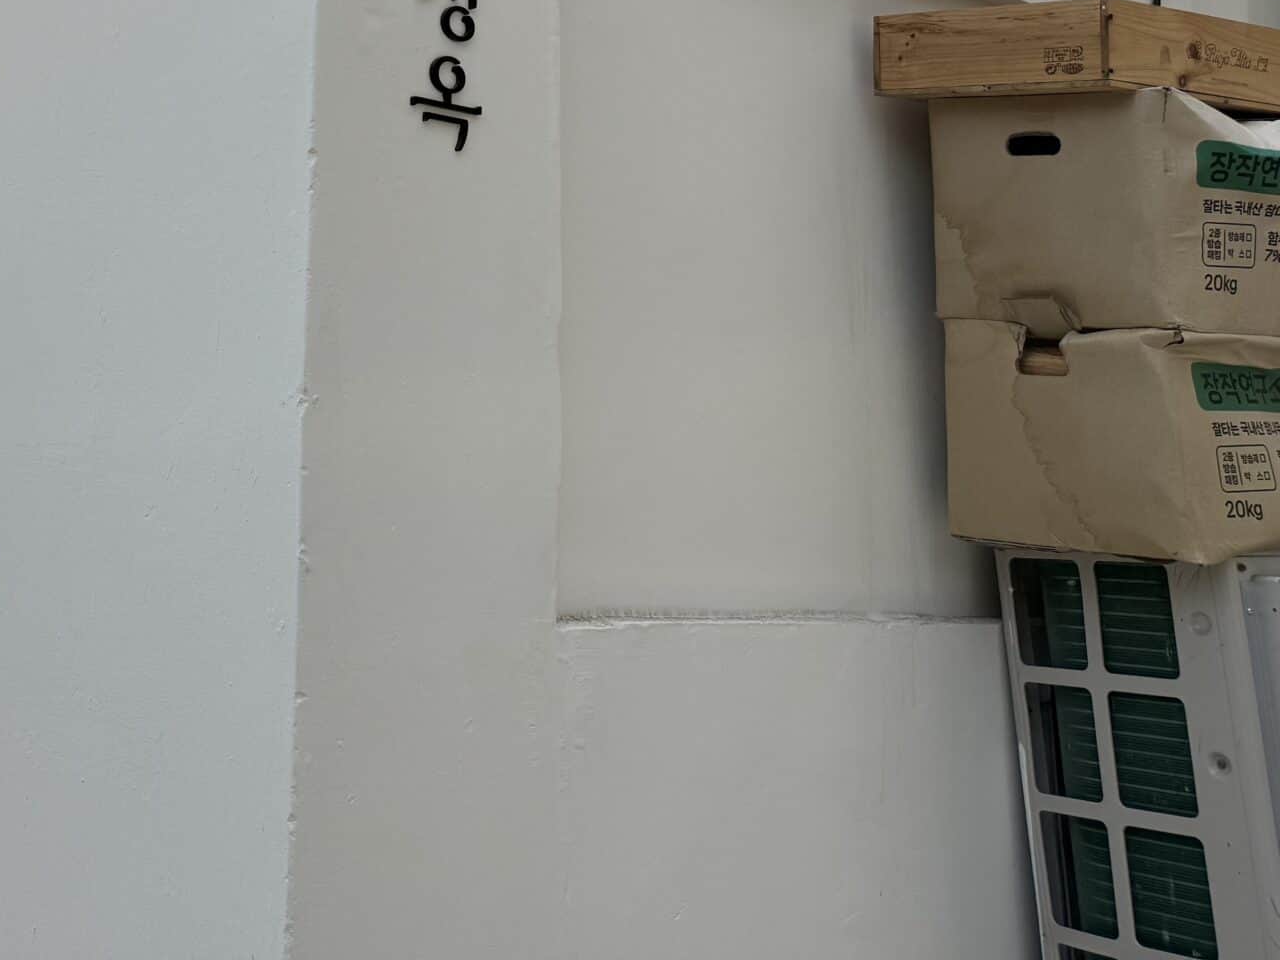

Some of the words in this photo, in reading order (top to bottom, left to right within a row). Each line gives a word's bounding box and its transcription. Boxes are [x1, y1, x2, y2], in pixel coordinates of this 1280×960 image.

[1202, 198, 1233, 214] 잘타는
[1234, 200, 1264, 216] 국내산
[1268, 231, 1280, 246] 함
[1204, 273, 1238, 295] 20kg
[1211, 421, 1240, 437] 잘타는
[1225, 500, 1264, 521] 20kg
